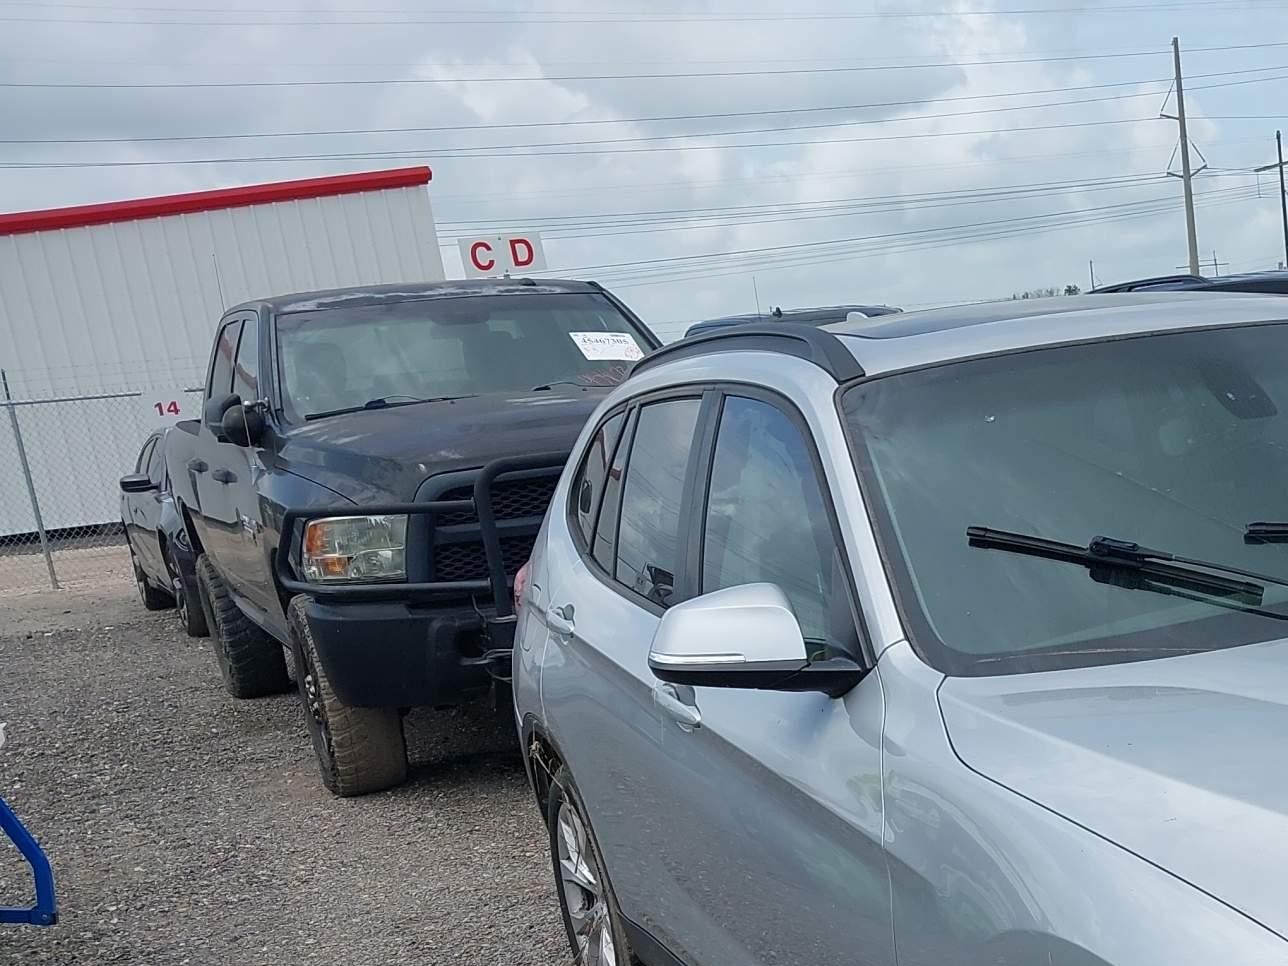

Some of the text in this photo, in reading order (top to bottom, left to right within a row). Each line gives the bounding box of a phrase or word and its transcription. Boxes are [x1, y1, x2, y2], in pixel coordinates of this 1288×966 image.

[470, 238, 535, 271] C D
[154, 401, 180, 417] 14
